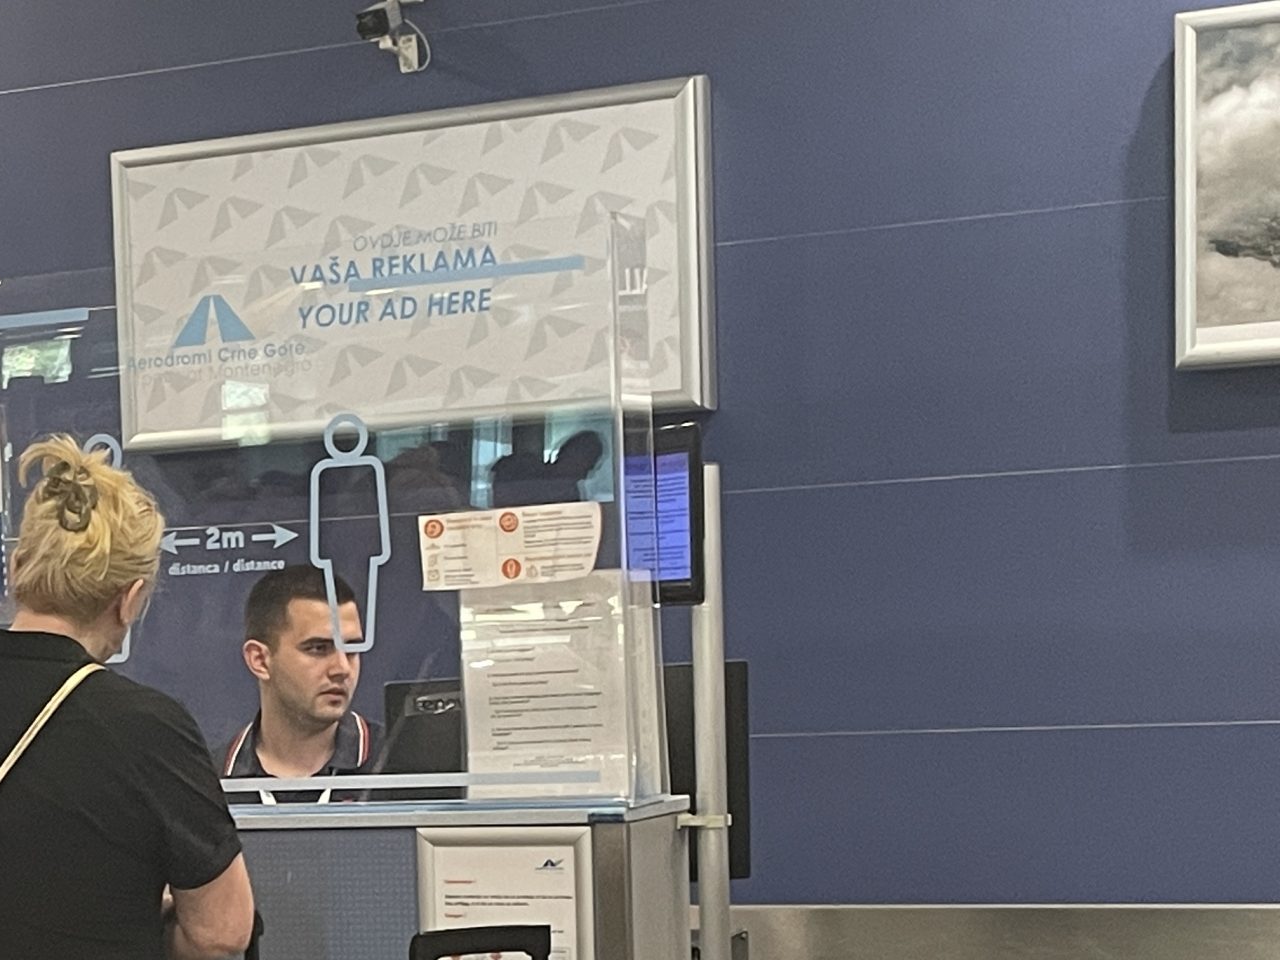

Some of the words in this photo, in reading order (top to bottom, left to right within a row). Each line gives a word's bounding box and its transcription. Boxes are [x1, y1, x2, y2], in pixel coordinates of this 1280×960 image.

[352, 229, 412, 252] OVDJE
[471, 221, 498, 239] BITI
[289, 255, 363, 285] VAŠA
[371, 245, 498, 279] REKLAMA
[298, 301, 370, 329] YOUR
[378, 296, 418, 322] AD
[427, 288, 492, 317] HERE
[205, 527, 245, 550] 2m
[168, 562, 220, 576] distanca
